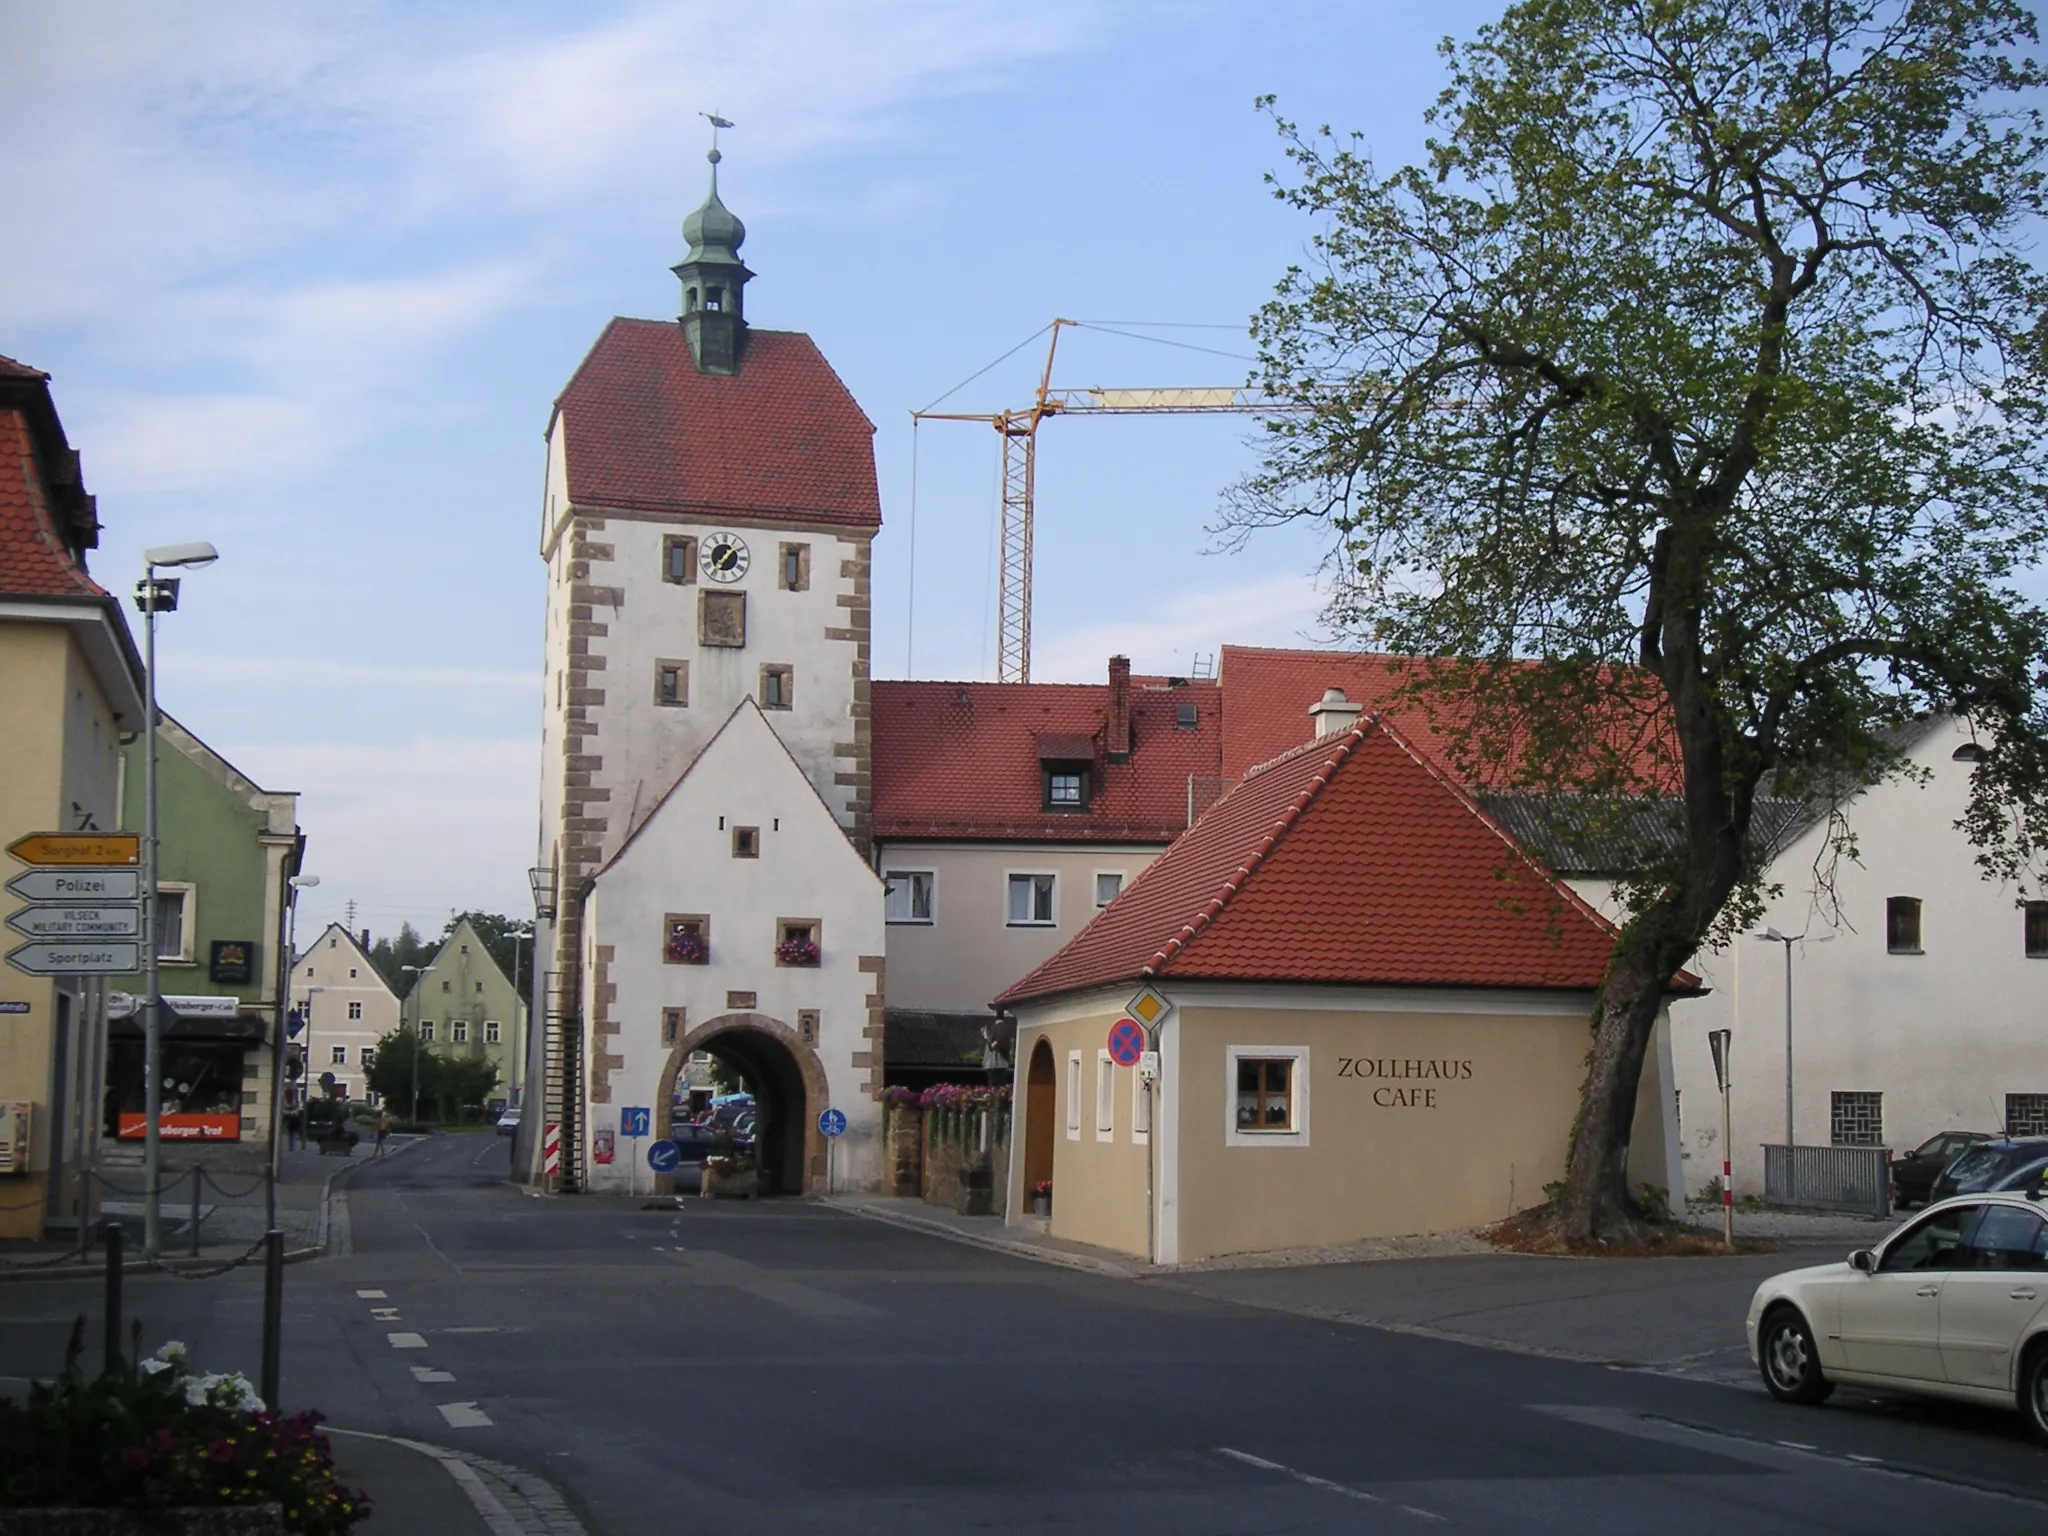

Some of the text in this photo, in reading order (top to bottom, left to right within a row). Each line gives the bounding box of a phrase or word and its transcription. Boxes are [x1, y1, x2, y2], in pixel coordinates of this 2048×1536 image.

[96, 845, 104, 856] 2
[55, 879, 105, 892] Polizei
[63, 910, 101, 921] VILSECK
[32, 922, 129, 932] MILITARY COMMUNITY
[47, 952, 113, 965] Sportplatz
[1337, 1056, 1473, 1080] ZOLLHAUS
[1372, 1087, 1437, 1109] CAFE
